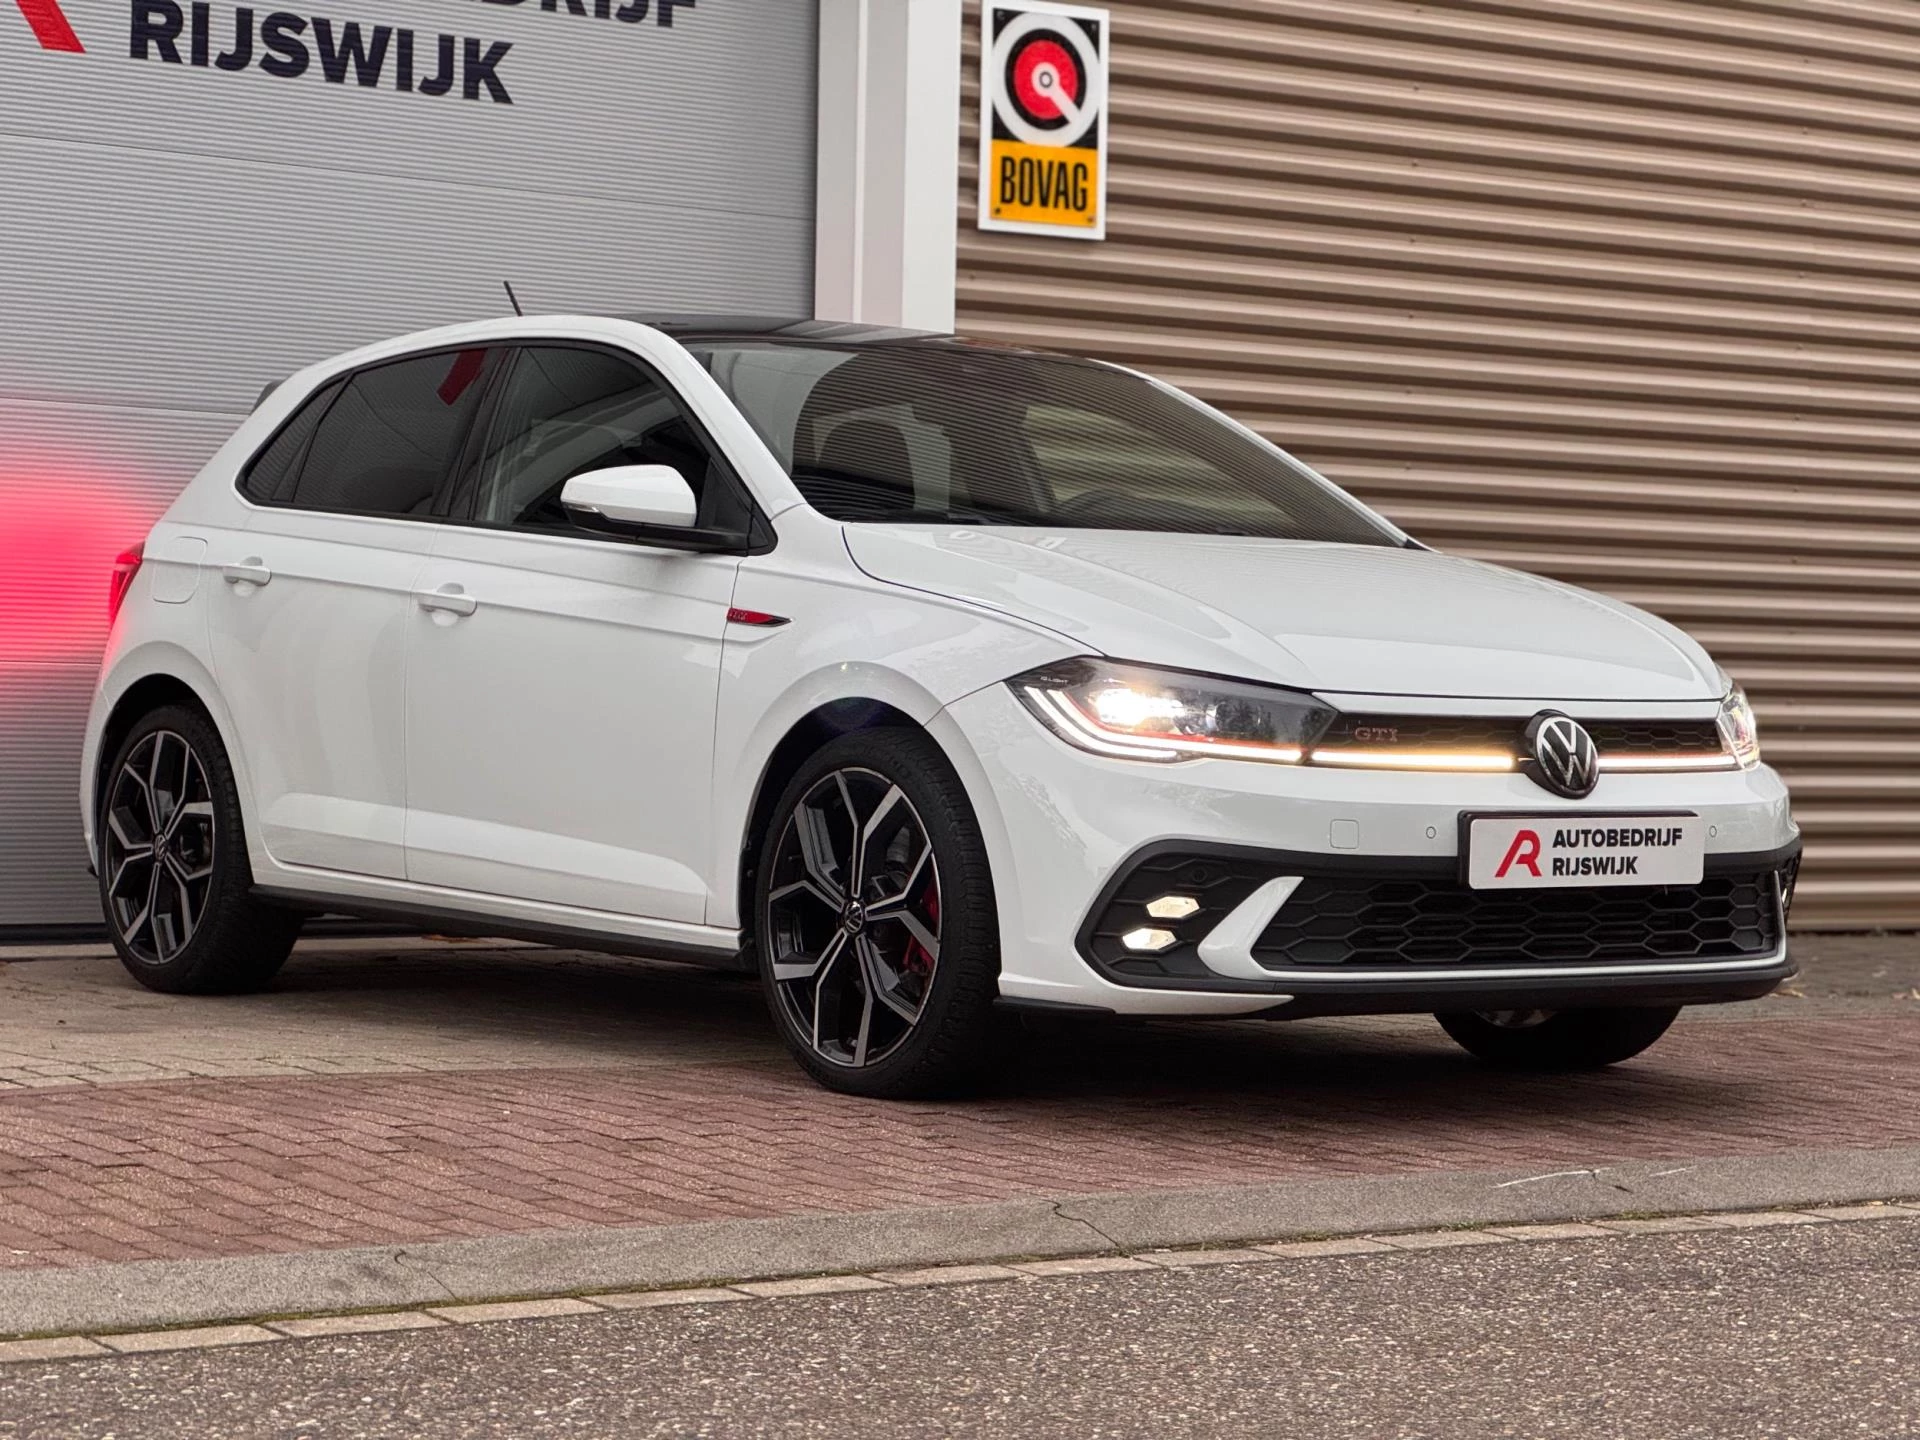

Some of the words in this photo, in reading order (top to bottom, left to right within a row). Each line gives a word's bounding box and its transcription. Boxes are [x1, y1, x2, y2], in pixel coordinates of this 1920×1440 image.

[129, 0, 514, 105] RIJSWIJK
[1000, 155, 1088, 212] BOVAG
[1355, 726, 1398, 742] GTI
[1552, 827, 1683, 849] AUTOBEDRIJF
[1552, 855, 1639, 877] RIJSWIJK
